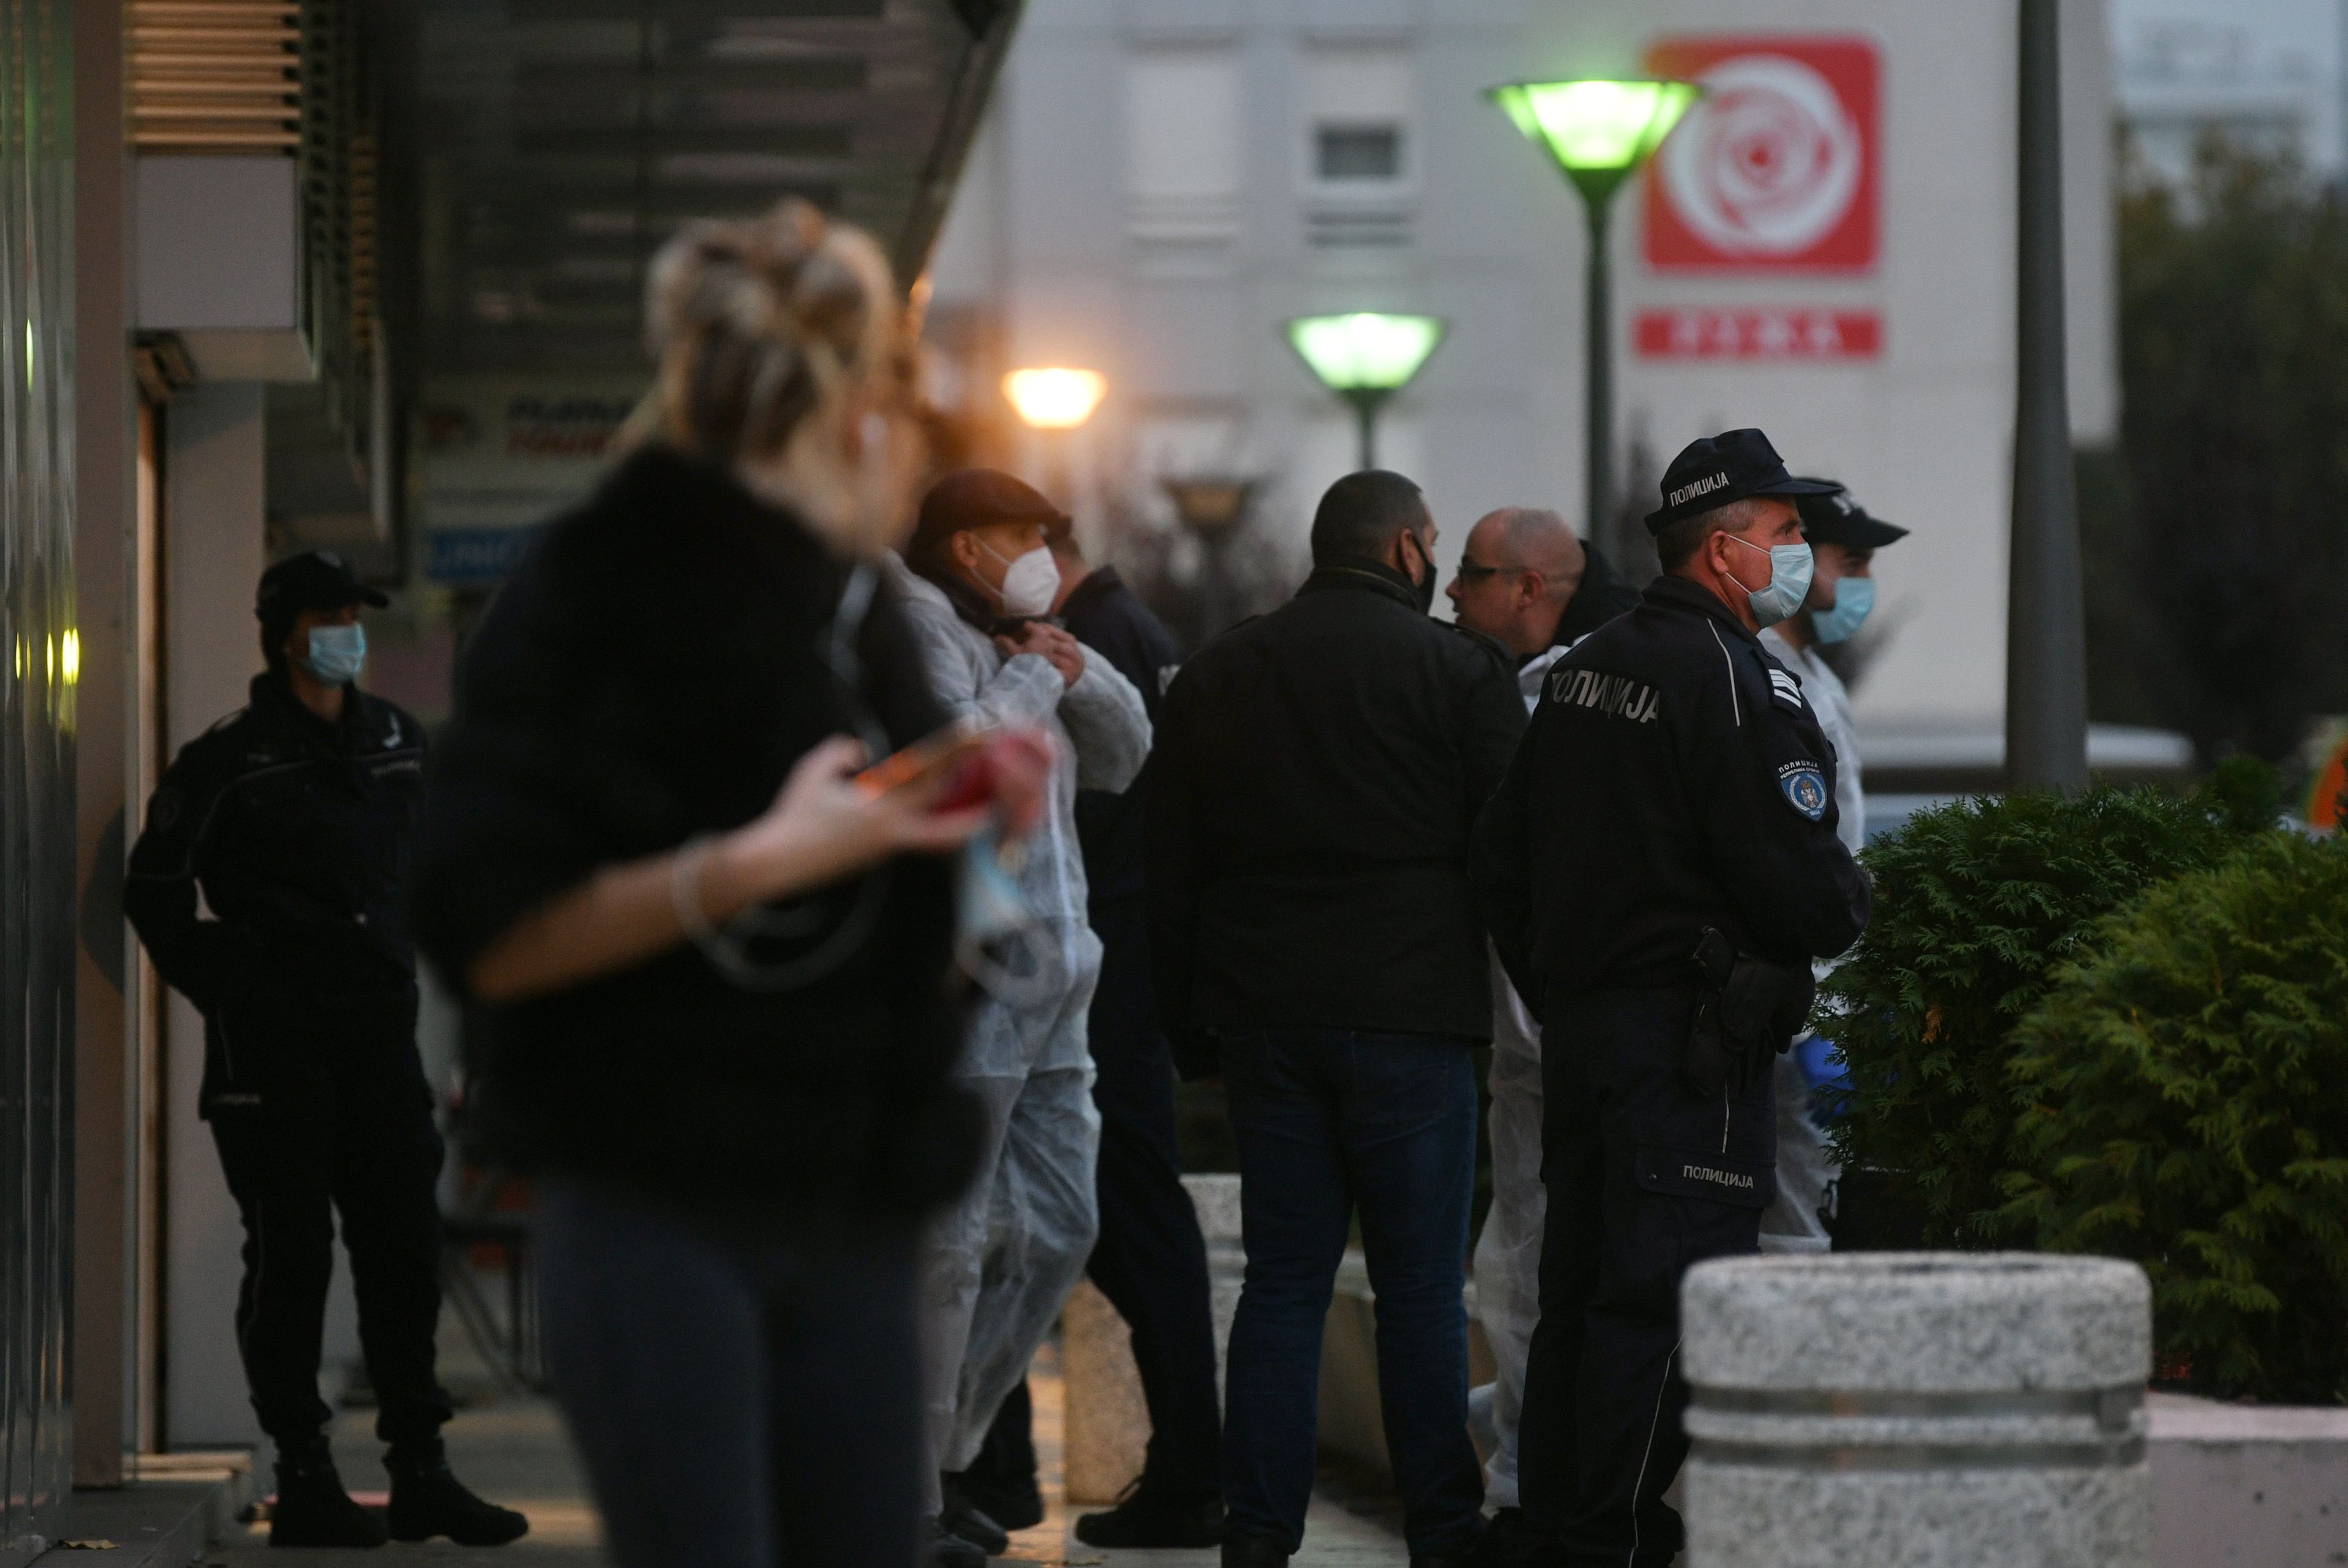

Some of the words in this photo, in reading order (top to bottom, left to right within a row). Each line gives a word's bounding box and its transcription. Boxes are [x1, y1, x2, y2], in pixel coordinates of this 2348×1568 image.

[1670, 472, 1729, 507] ПОЛИЦИЈА
[1779, 760, 1818, 773] ПОЛИЦИЈА
[1683, 1165, 1754, 1189] ПОЛИЦИЈА
